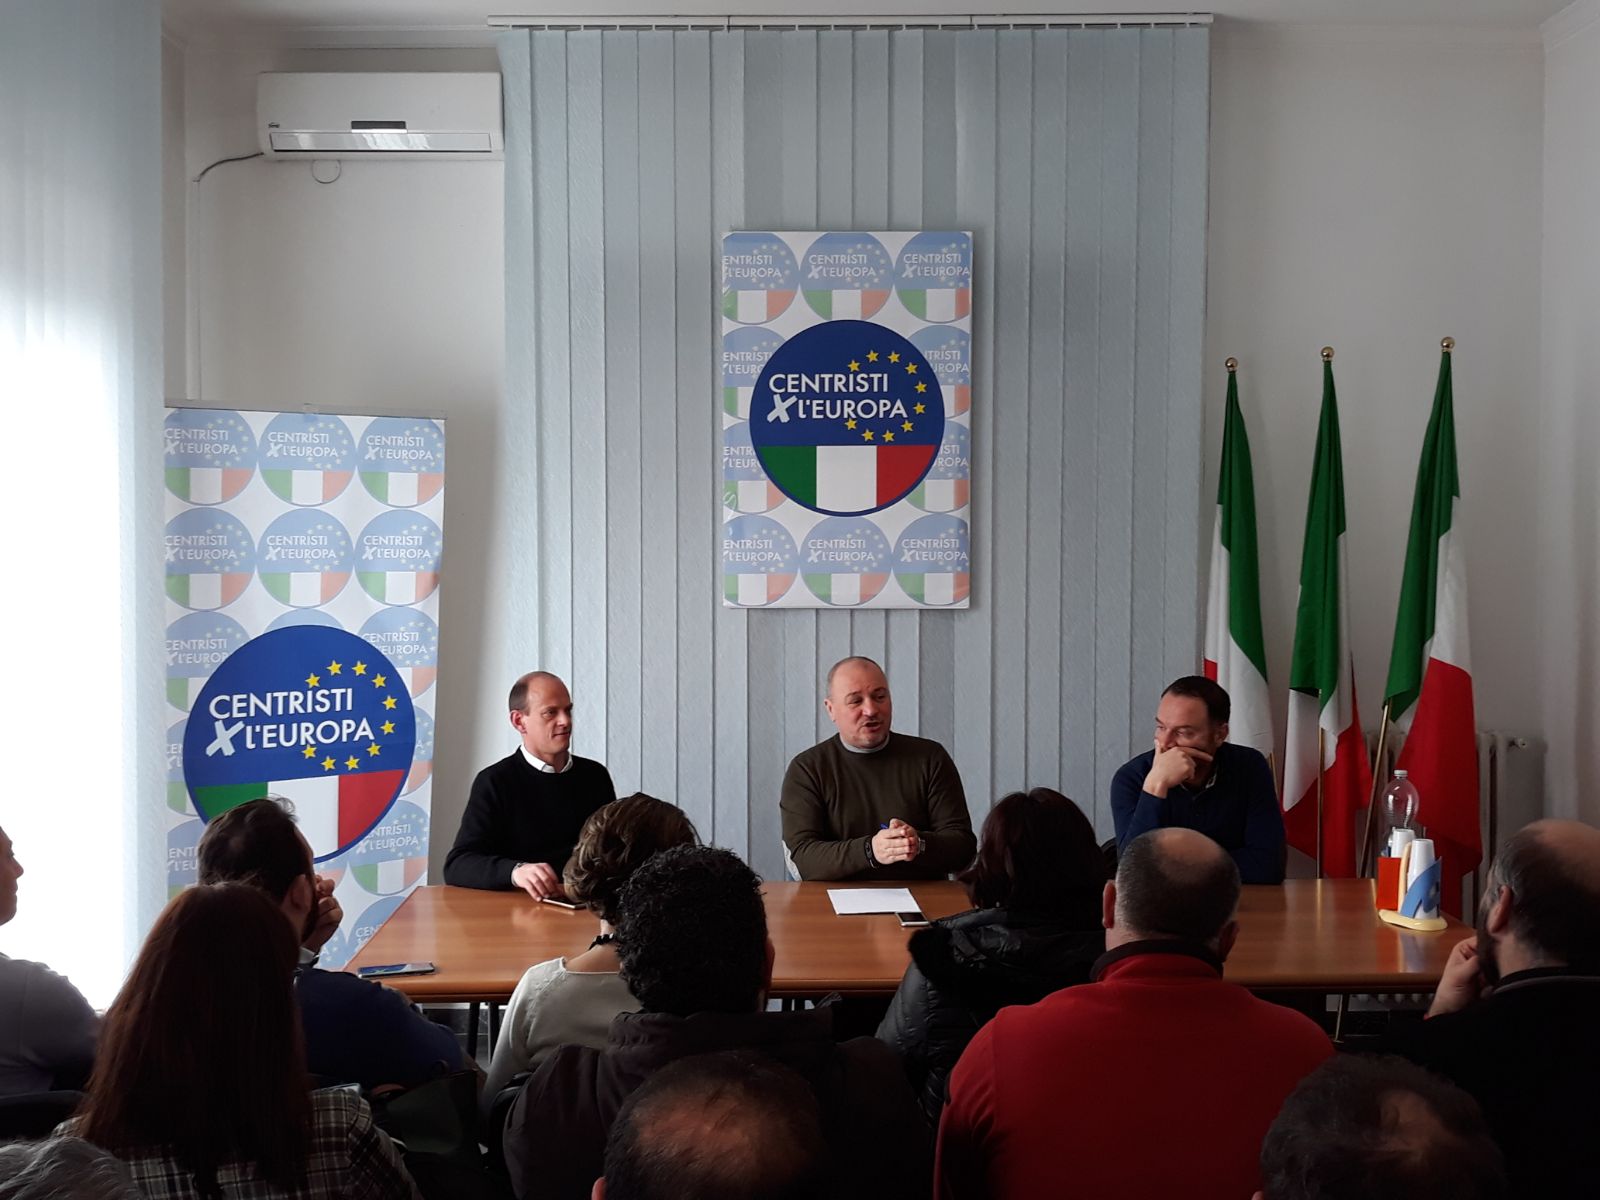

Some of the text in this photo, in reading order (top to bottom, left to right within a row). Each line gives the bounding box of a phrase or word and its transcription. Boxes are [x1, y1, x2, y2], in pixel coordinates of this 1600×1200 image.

[721, 255, 773, 265] ENTRISTI
[808, 254, 867, 265] CENTRISTI
[903, 253, 962, 264] CENTRISTI
[769, 373, 888, 394] CENTRISTI
[165, 428, 229, 441] CENTRISTI
[267, 431, 330, 444] CENTRISTI
[366, 435, 424, 447] CENTRISTI
[164, 535, 228, 546] CENTRISTI
[266, 535, 328, 547] CENTRISTI
[363, 535, 423, 546] CENTRISTI
[722, 539, 773, 549] ENTRISTI
[808, 539, 866, 550] CENTRISTI
[901, 538, 960, 549] CENTRISTI
[209, 688, 353, 720] CENTRISTI
